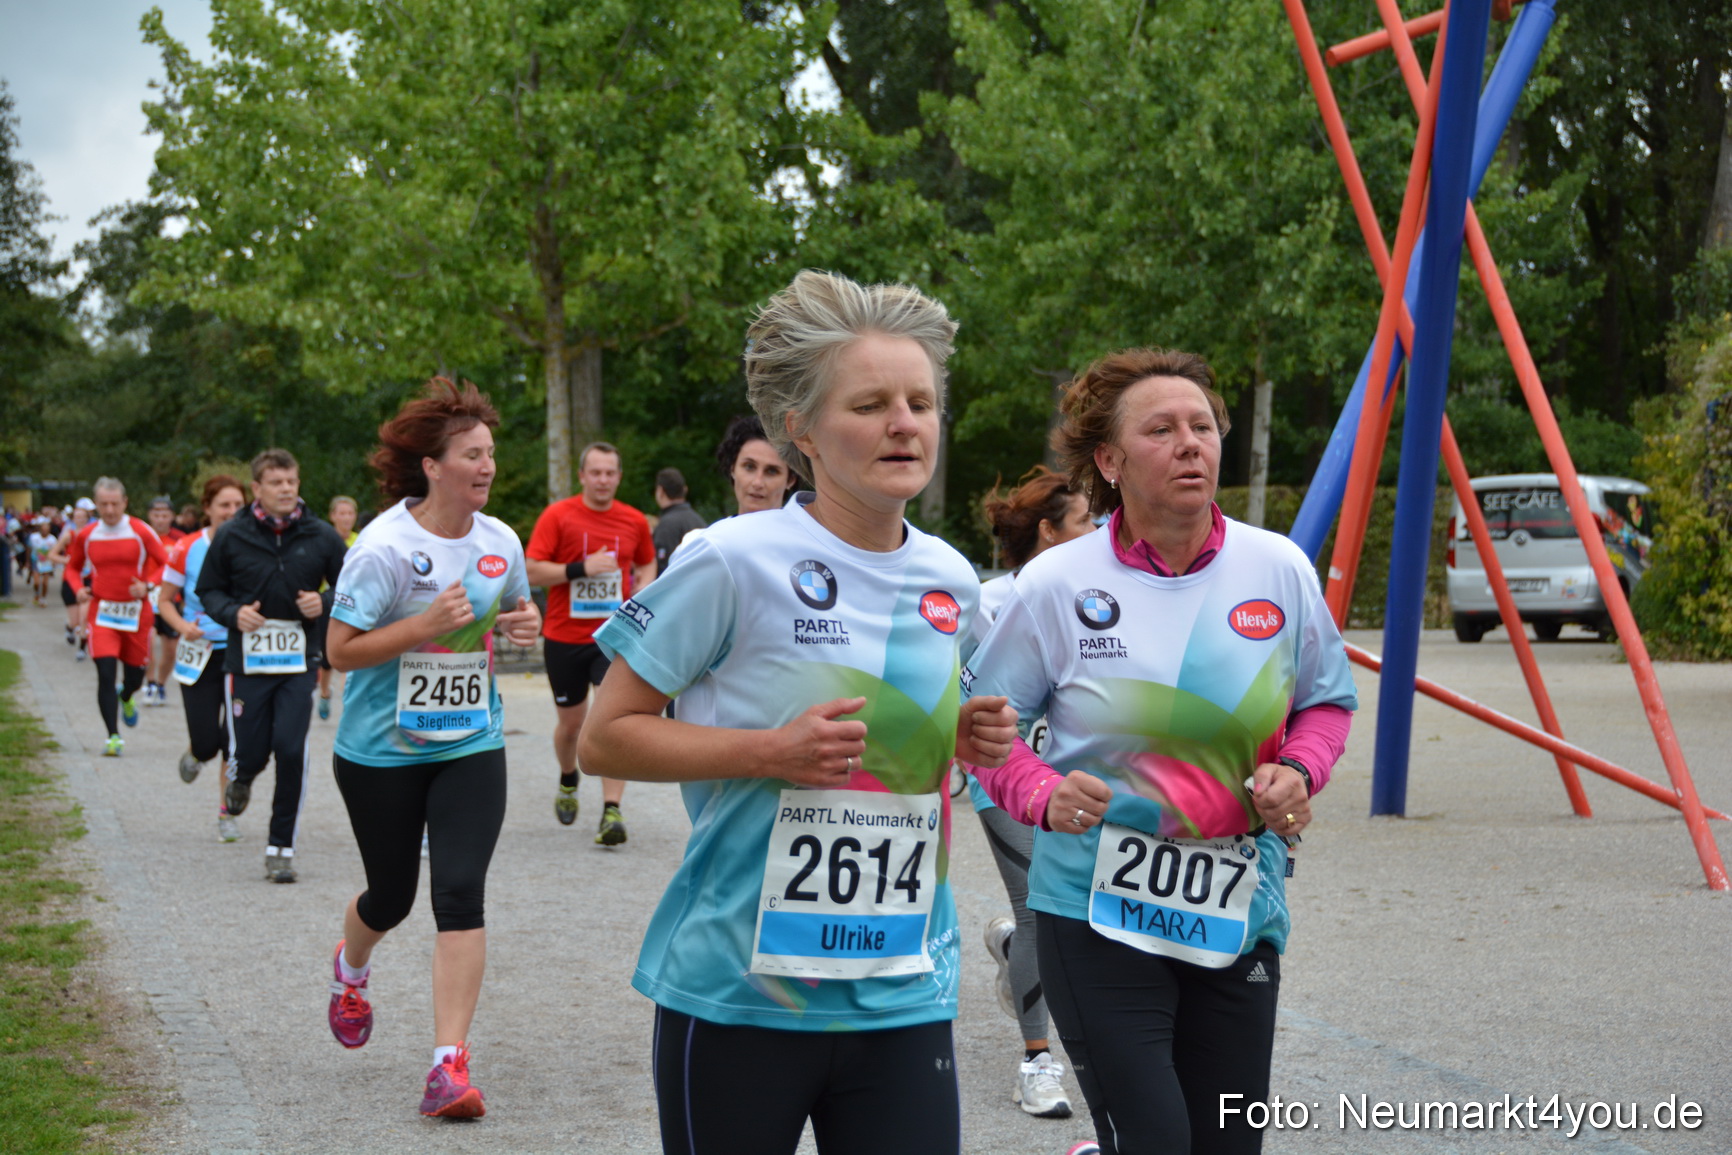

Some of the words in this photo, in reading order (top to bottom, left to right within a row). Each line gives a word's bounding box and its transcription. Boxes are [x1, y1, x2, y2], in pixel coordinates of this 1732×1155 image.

[791, 561, 834, 581] BMW
[576, 581, 618, 600] 2634
[1076, 589, 1116, 605] BMW
[794, 619, 849, 635] PARTL
[1236, 610, 1279, 630] Hervis
[250, 631, 300, 653] 2102
[794, 634, 851, 646] Neumarkt
[1079, 637, 1127, 651] PARTL
[1080, 649, 1128, 660] Neumarkt
[402, 660, 436, 670] PARTL
[437, 662, 477, 671] Neumarkt
[409, 674, 482, 706] 2456
[417, 714, 473, 730] Sieglinde
[779, 807, 838, 824] PARTL
[842, 808, 924, 829] Neumarkt
[783, 834, 928, 904] 2614
[1110, 836, 1248, 910] 2007
[1120, 897, 1208, 945] MARA
[820, 923, 886, 952] Ulrike
[1246, 974, 1270, 983] adidas
